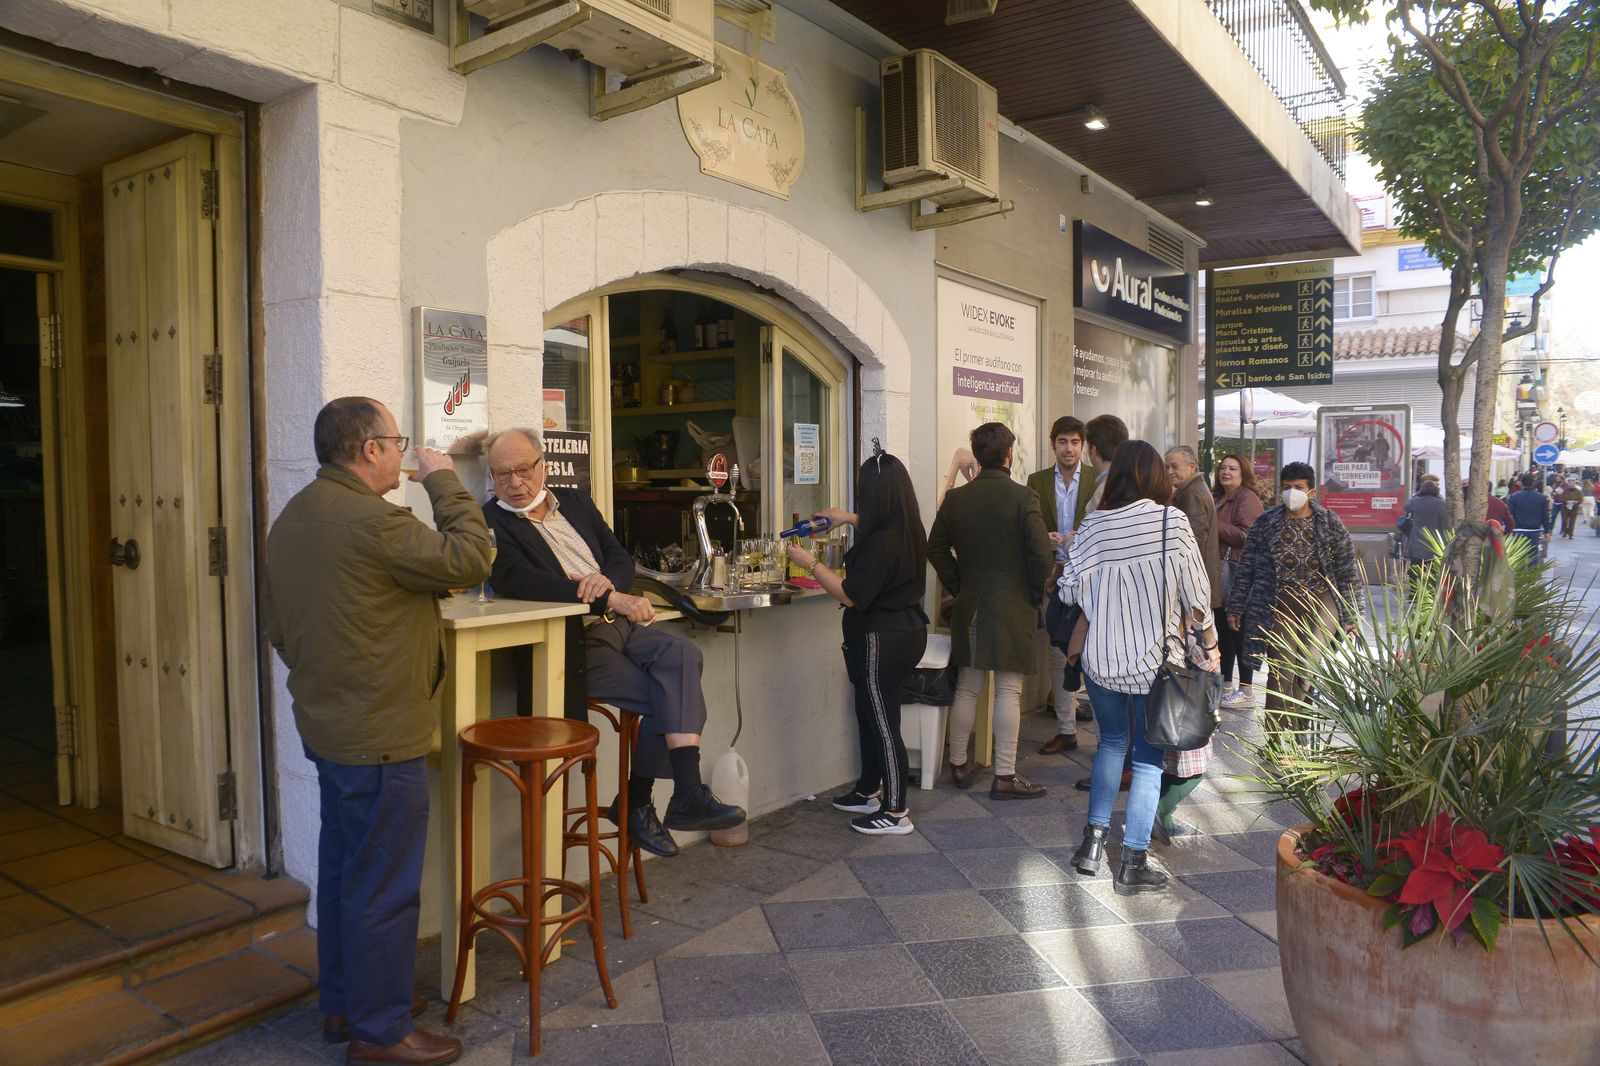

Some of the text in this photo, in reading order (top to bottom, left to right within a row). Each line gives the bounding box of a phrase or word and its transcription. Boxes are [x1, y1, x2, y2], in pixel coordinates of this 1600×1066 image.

[717, 106, 779, 150] LA CATA
[1112, 257, 1152, 311] Aural
[1215, 288, 1240, 296] Baños
[1215, 291, 1280, 303] Reales Merinies
[961, 302, 1015, 329] WIDEX EVOKE
[1215, 304, 1293, 316] Murallas Merinies
[428, 322, 484, 341] LA CATA
[1215, 321, 1243, 330] parque
[1240, 326, 1273, 335] Cristina
[1215, 337, 1245, 345] escuela
[1248, 336, 1258, 344] de
[1261, 342, 1288, 351] diseño
[442, 356, 471, 367] Guijuelo
[955, 348, 962, 361] El
[962, 352, 985, 366] primer
[1011, 363, 1023, 374] con
[1215, 356, 1289, 367] Hornos Romanos
[1075, 364, 1095, 380] mejorar
[1248, 374, 1272, 382] barrio
[1307, 371, 1331, 379] Isidro
[957, 374, 1021, 396] inteligencia artificial
[1076, 381, 1100, 397] bienestar
[539, 438, 589, 454] STELERIA
[560, 461, 575, 477] LA
[1351, 463, 1368, 471] PARA
[1341, 471, 1380, 480] SOBREVIVIR
